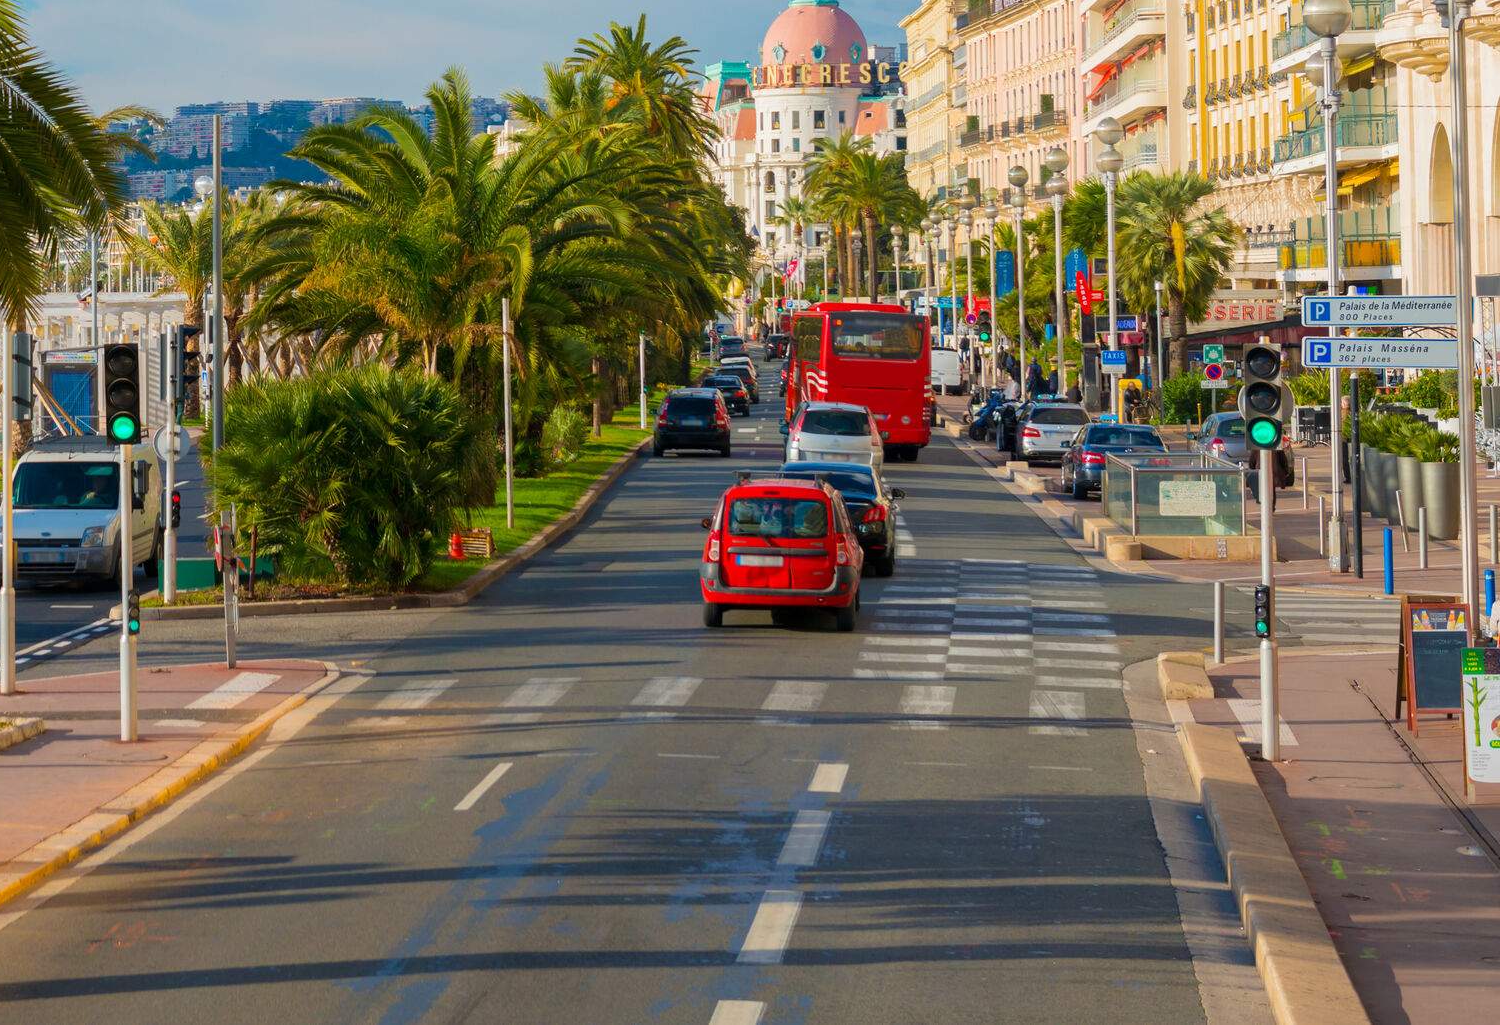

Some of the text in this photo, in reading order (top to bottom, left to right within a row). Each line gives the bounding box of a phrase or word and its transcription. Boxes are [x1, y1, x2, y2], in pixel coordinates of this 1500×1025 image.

[1079, 279, 1088, 306] TABAC
[1339, 301, 1366, 311] Palais
[1368, 300, 1380, 311] de
[1381, 301, 1390, 310] la
[1391, 300, 1453, 310] Méditerranée
[1339, 313, 1393, 321] 800 Places
[1338, 343, 1373, 353] Palais
[1381, 343, 1429, 353] Masséna
[1104, 352, 1125, 360] TAXIS
[1338, 354, 1392, 364] 362 places
